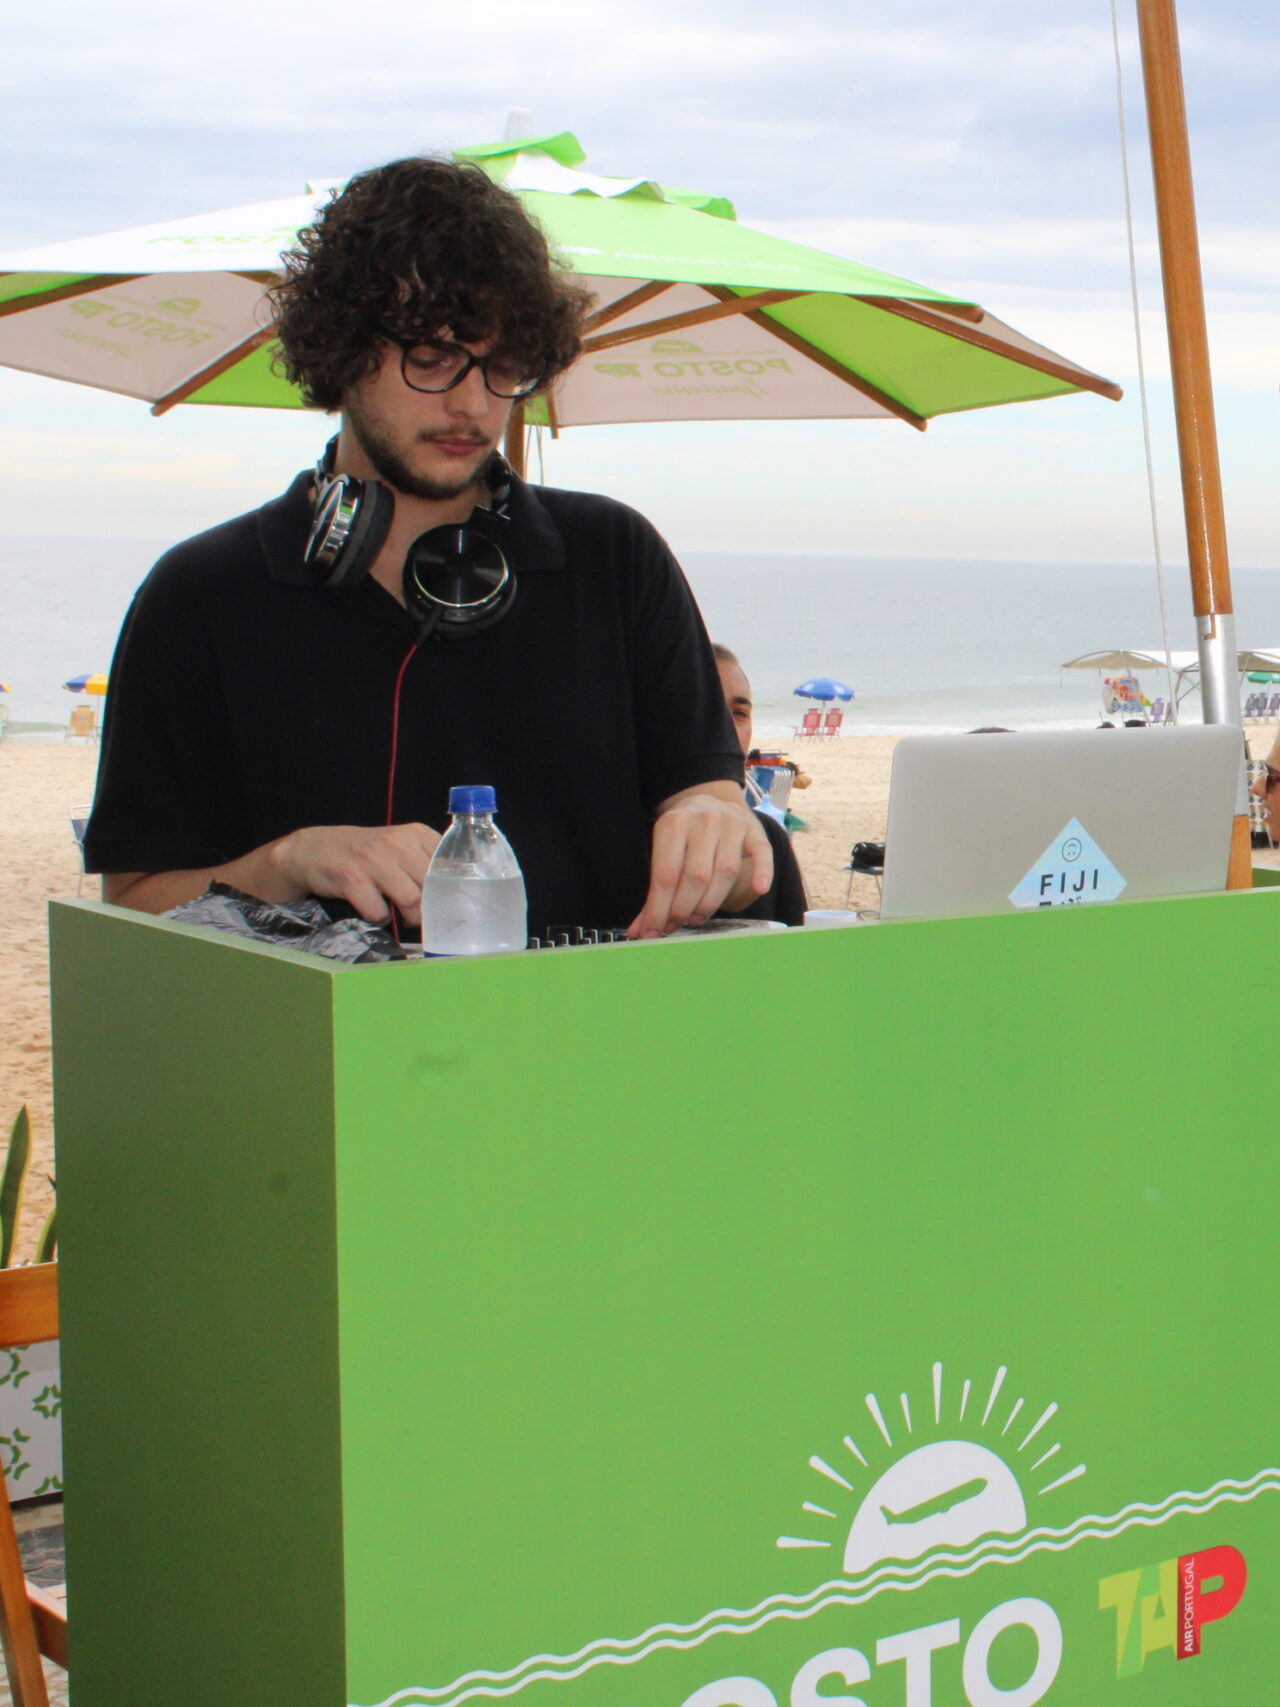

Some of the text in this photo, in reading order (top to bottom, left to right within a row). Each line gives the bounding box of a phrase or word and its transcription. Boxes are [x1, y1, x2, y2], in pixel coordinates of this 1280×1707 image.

[1040, 869, 1098, 896] FIJI
[1098, 1544, 1248, 1680] TAP
[1184, 1557, 1195, 1652] AIR PORTUGAL
